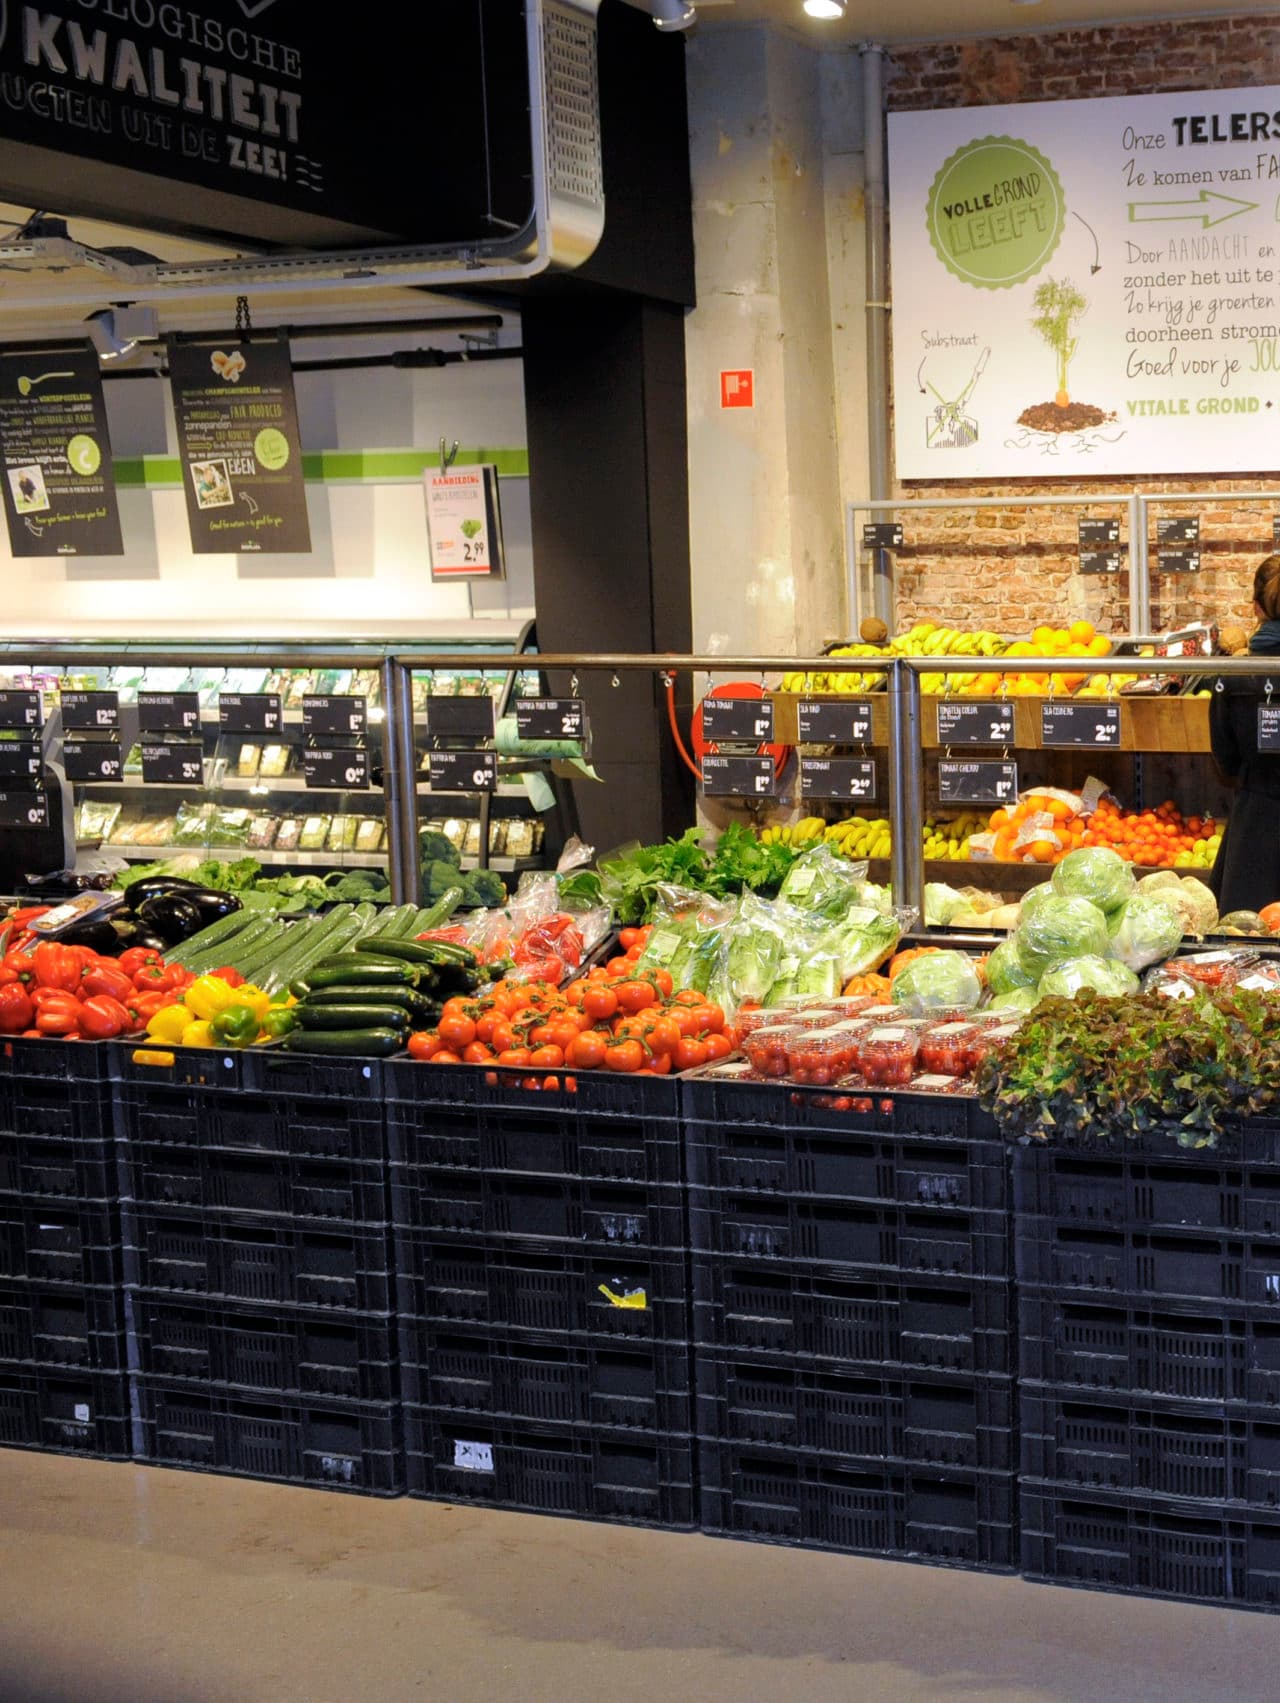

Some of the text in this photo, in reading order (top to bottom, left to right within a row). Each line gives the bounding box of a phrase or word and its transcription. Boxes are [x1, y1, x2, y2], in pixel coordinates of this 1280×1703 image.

[75, 0, 301, 79] LOGISCHE
[23, 6, 301, 143] KWALITEIT
[121, 104, 170, 150] UIT
[182, 122, 220, 162] DE
[226, 135, 288, 181] ZEE!
[1122, 126, 1166, 151] Onze
[1122, 158, 1147, 187] Ze
[1153, 166, 1213, 185] komen
[1218, 165, 1251, 183] van
[949, 202, 1048, 256] LEEFT
[1126, 241, 1163, 265] Door
[1168, 232, 1249, 263] AANDACHT
[1258, 244, 1275, 258] en
[1123, 268, 1184, 289] zonder
[1190, 268, 1220, 286] het
[1224, 268, 1251, 285] uit
[1256, 267, 1273, 283] te
[1123, 290, 1146, 315] Zo
[1149, 293, 1184, 325] krijg
[1187, 296, 1203, 325] je
[1209, 288, 1273, 322] groenten
[921, 330, 978, 348] Substraat
[1126, 322, 1214, 343] doorheen
[1126, 346, 1175, 379] Goed
[1182, 355, 1218, 374] voor
[1220, 355, 1241, 387] je
[1127, 398, 1190, 417] VITALE
[1196, 396, 1260, 415] GROND
[463, 542, 484, 562] 2.99
[1262, 710, 1280, 719] TOMAAT
